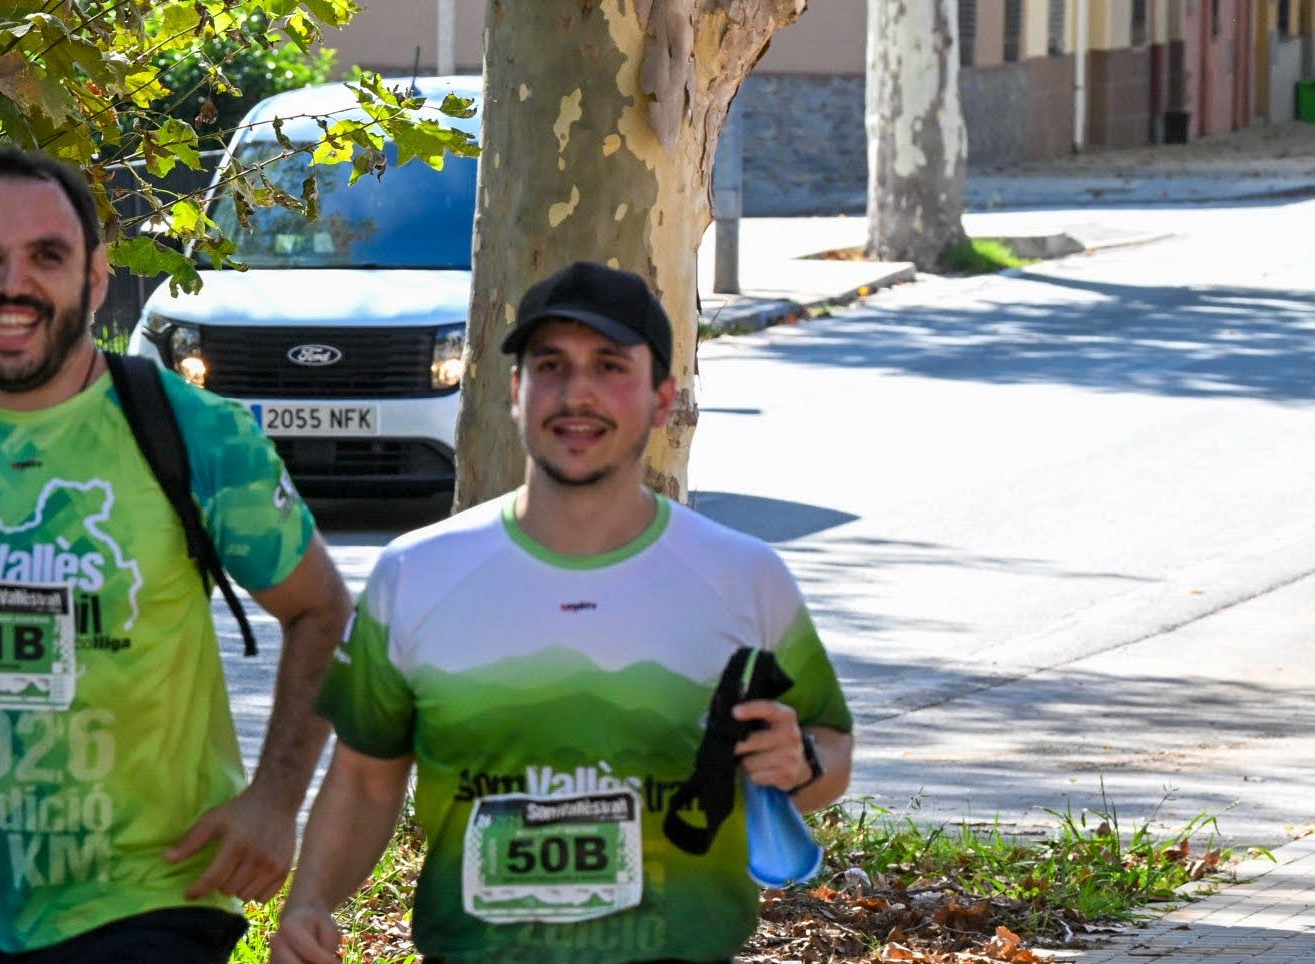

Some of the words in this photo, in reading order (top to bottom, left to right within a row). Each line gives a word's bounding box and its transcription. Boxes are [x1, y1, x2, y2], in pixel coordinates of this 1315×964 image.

[266, 407, 322, 429] 2055
[329, 408, 372, 429] NFK
[6, 831, 113, 893] KM
[506, 835, 609, 875] 50B
